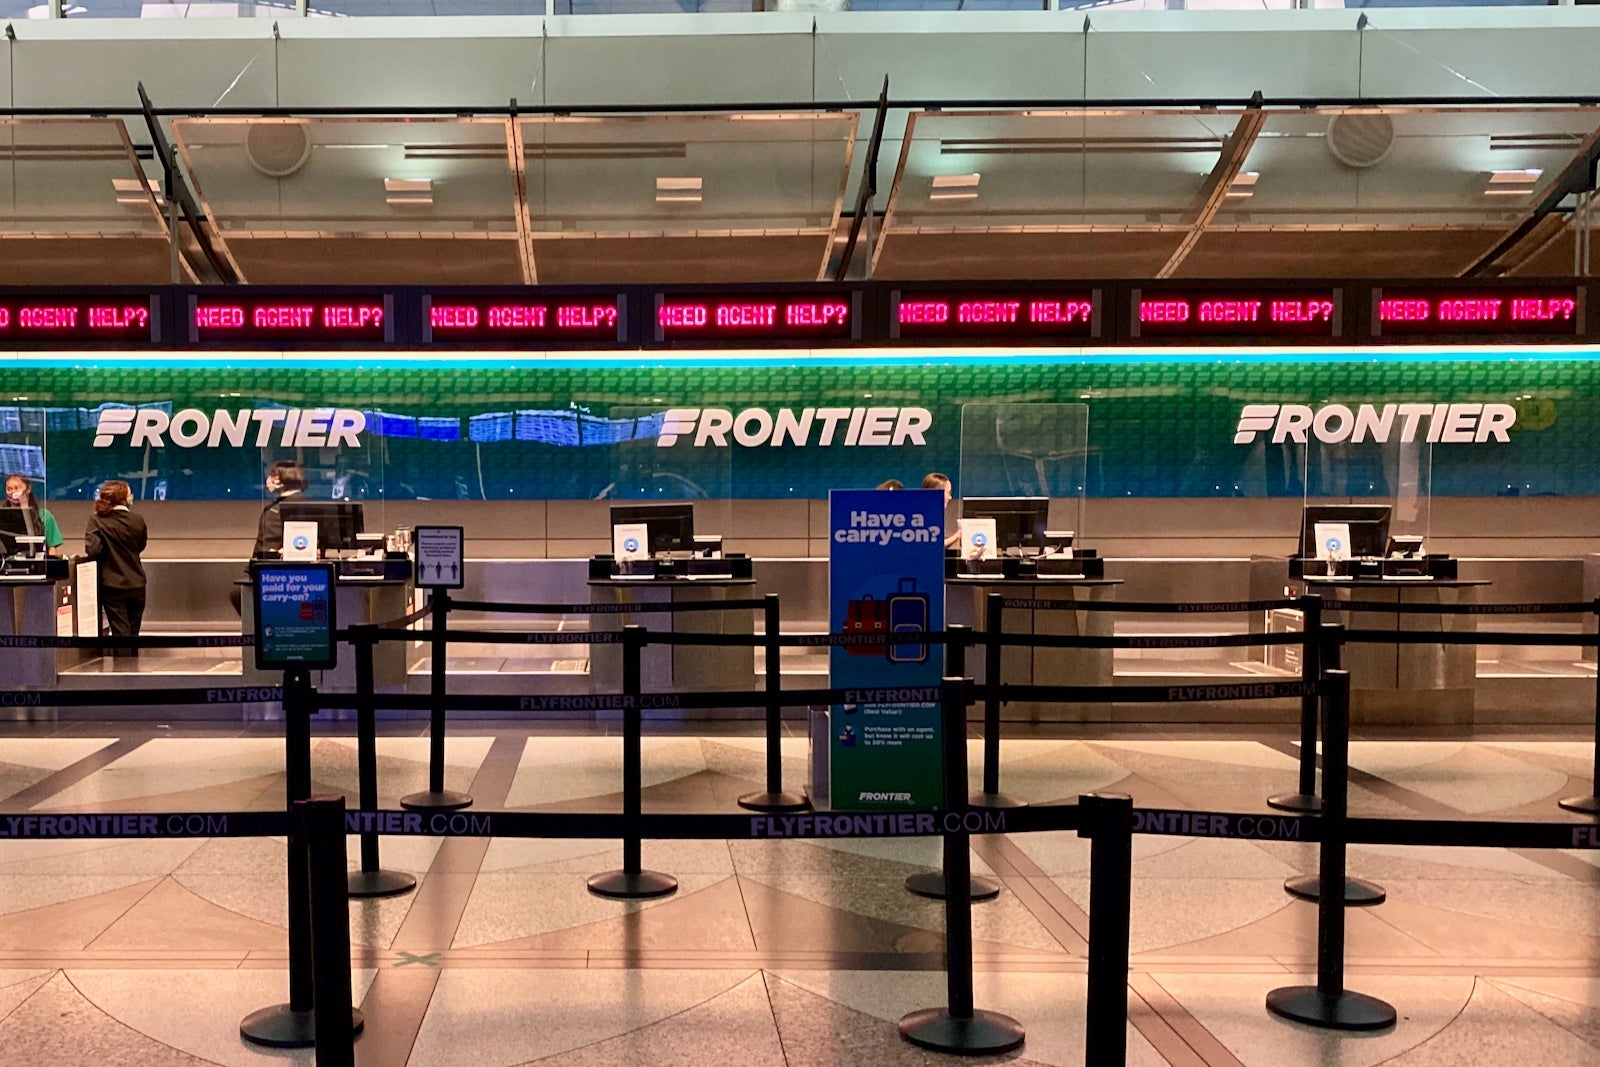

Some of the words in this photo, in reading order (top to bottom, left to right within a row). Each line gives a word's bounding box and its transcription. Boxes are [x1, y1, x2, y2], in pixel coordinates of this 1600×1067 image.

[19, 307, 78, 328] AGENT
[88, 307, 148, 328] HELP?
[195, 306, 244, 328] NEED
[254, 306, 314, 328] AGENT
[323, 306, 384, 328] HELP?
[430, 306, 478, 328] NEED
[487, 306, 547, 328] AGENT
[557, 306, 618, 328] HELP?
[658, 304, 707, 327] NEED
[716, 304, 776, 327] AGENT
[786, 304, 848, 327] HELP?
[898, 302, 948, 324] NEED
[958, 302, 1020, 324] AGENT
[1030, 302, 1093, 324] HELP?
[1140, 300, 1190, 323] NEED
[1199, 300, 1261, 323] AGENT
[1271, 300, 1334, 323] HELP?
[1379, 298, 1430, 321] NEED
[1438, 298, 1502, 321] AGENT
[1511, 298, 1576, 321] HELP?
[93, 408, 366, 449] FRONTIER
[656, 407, 933, 447] FRONTIER
[1234, 403, 1517, 444] FRONTIER
[850, 511, 905, 528] Have
[911, 514, 925, 528] a
[835, 526, 941, 546] carry-on?
[262, 574, 287, 583] Have
[289, 575, 308, 584] you
[262, 584, 284, 594] paid
[286, 584, 300, 592] for
[302, 585, 326, 593] your
[262, 593, 310, 604] carry-on?
[519, 695, 679, 709] FLYFRONTIER.COM
[845, 688, 942, 703] FLYFRONTI
[1168, 683, 1315, 701] FLYFRONTIER.COM
[859, 792, 912, 801] FRONTIER
[750, 810, 1007, 837] FLYFRONTIER.COM
